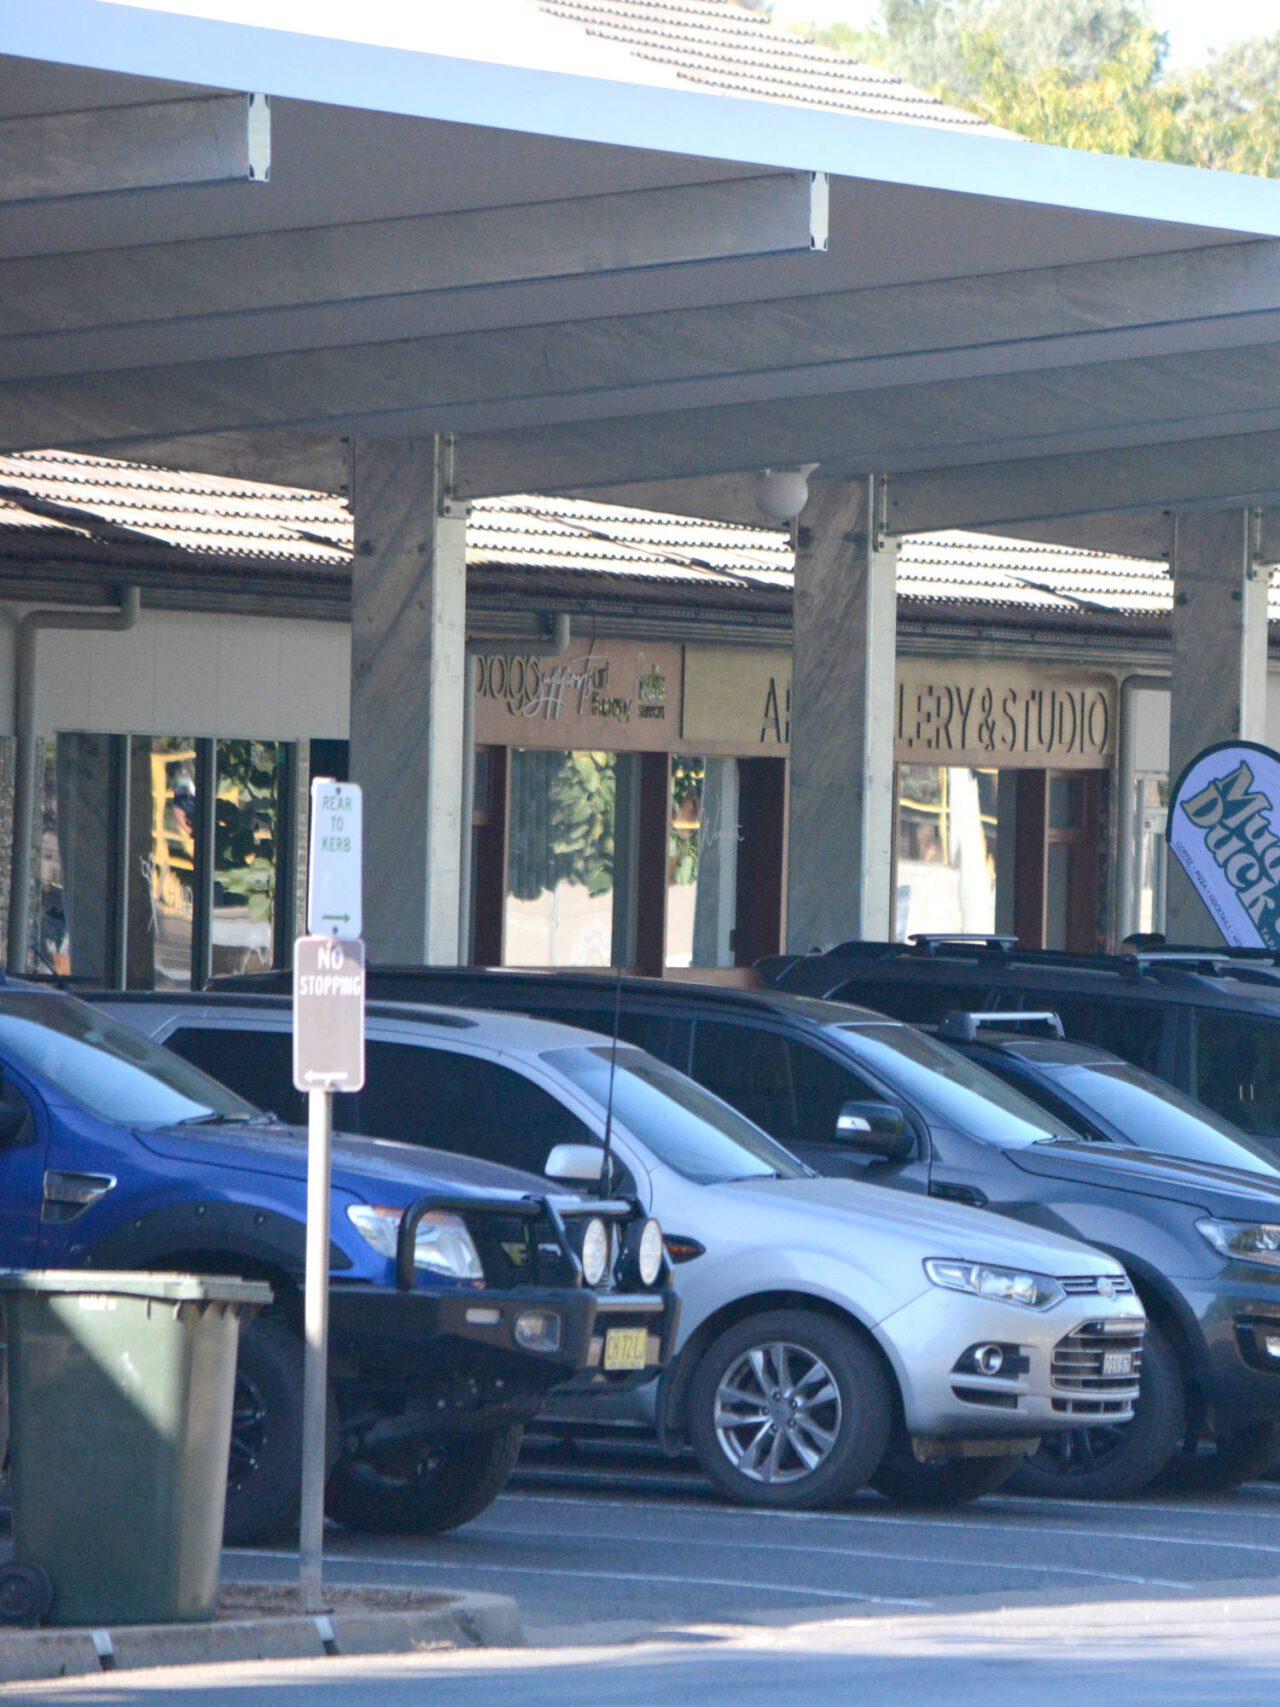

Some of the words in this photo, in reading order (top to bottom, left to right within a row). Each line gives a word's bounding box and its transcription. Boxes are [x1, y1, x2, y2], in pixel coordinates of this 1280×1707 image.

[322, 795, 352, 811] REAR
[331, 816, 344, 832] TO
[321, 837, 351, 853] KERB
[1180, 781, 1275, 928] Duck
[1176, 841, 1194, 866] COFFEE
[1195, 870, 1208, 890] PIZZA
[1208, 894, 1232, 931] COCKTAILS
[318, 946, 344, 970] NO
[300, 975, 361, 997] STOPPING
